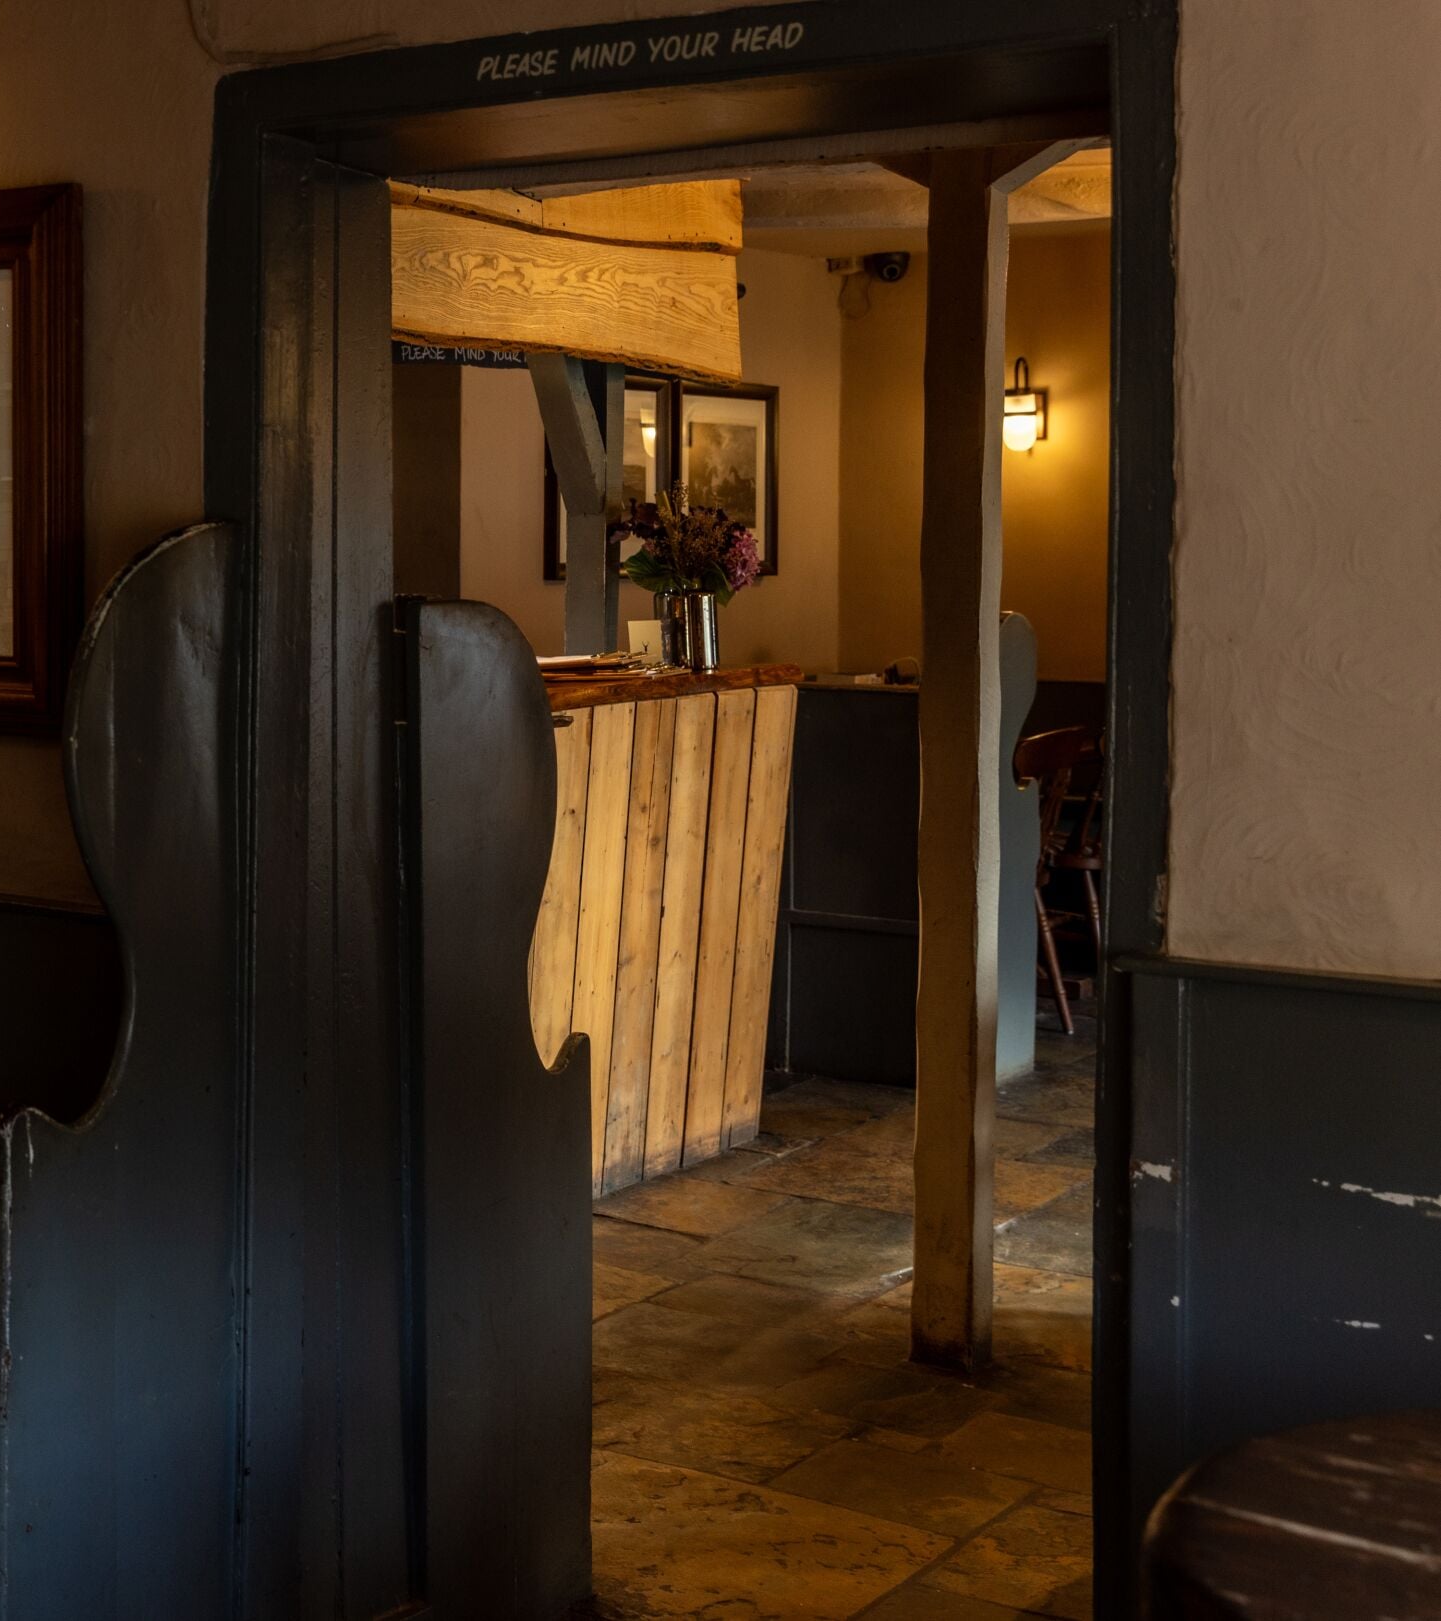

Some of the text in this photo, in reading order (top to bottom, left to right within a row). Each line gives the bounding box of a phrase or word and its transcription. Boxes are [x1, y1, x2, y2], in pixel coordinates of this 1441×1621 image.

[476, 22, 805, 82] PLEASE MIND YOUR HEAD
[400, 345, 447, 361] PLEASE
[454, 346, 487, 361] MIND
